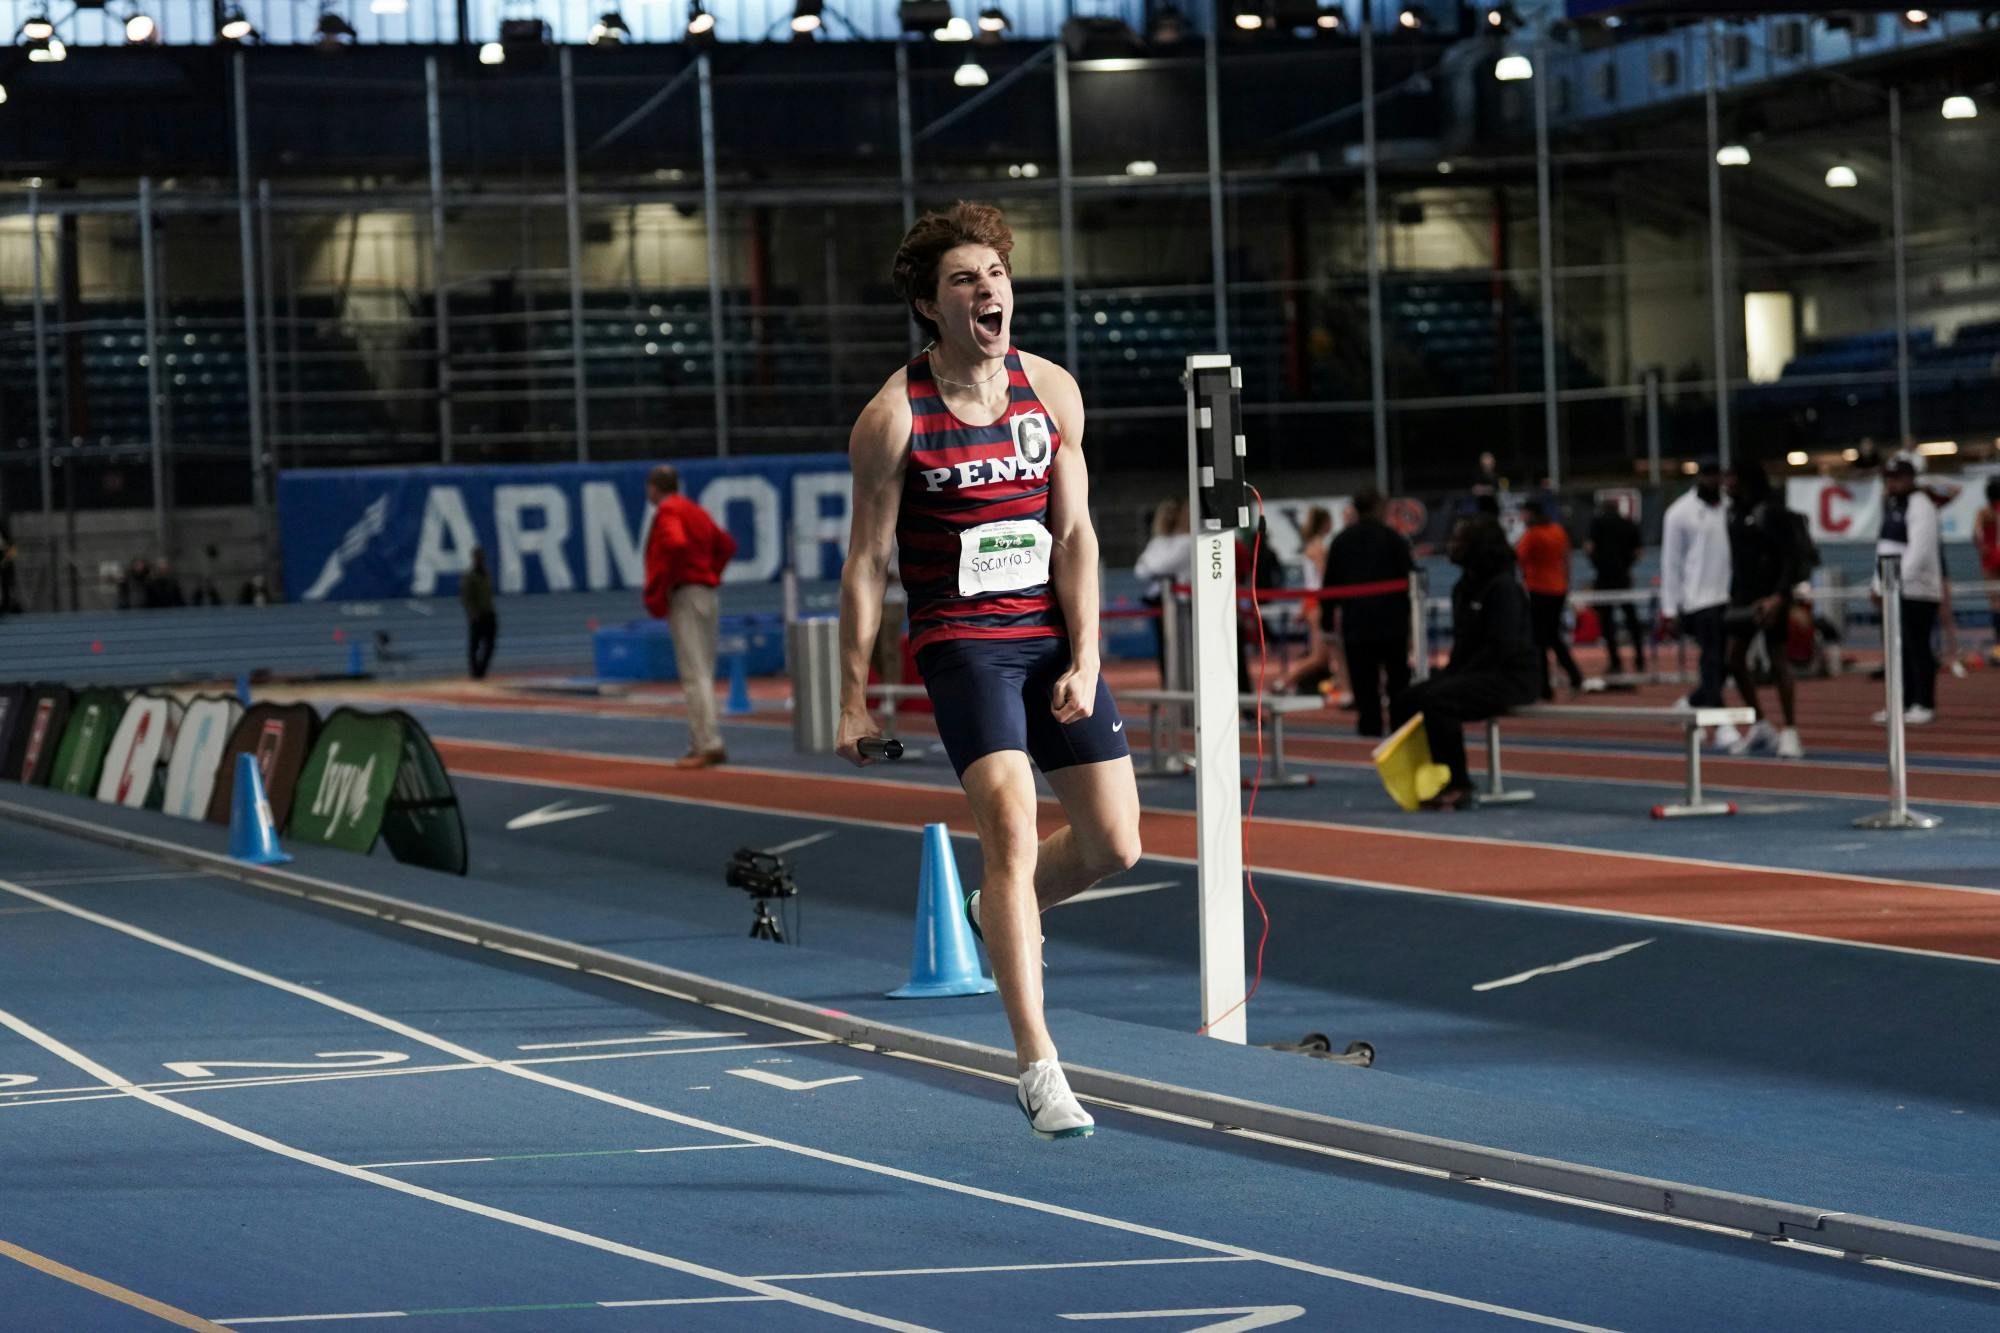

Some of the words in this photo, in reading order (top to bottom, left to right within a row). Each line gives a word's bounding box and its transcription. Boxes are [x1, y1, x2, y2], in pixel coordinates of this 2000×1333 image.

[1017, 416, 1047, 464] 6
[920, 455, 1046, 492] PENN
[971, 550, 1032, 573] Socarras
[1212, 551, 1222, 580] UCS
[162, 1051, 411, 1078] 2
